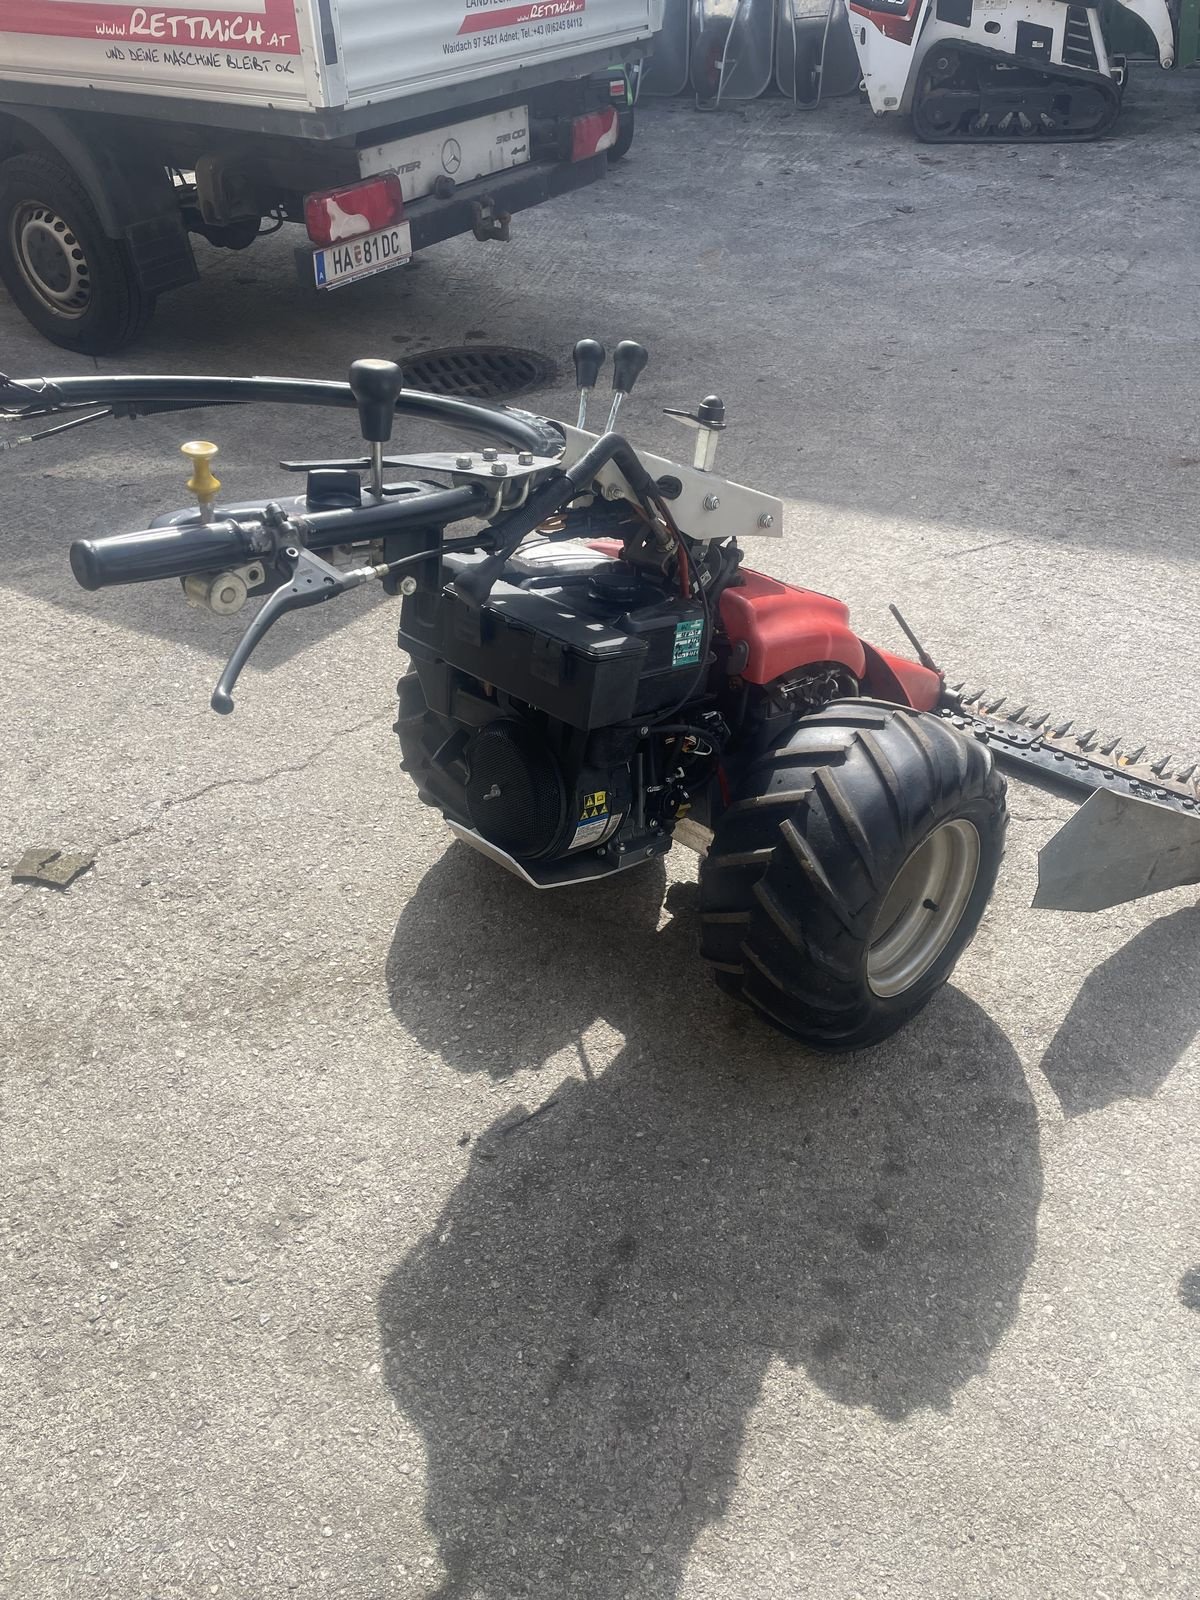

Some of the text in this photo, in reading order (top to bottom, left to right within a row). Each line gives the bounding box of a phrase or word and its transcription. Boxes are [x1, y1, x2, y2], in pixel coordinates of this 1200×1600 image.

[442, 39, 472, 54] Waidach
[473, 37, 481, 49] 97
[482, 34, 498, 47] 5421
[566, 17, 583, 30] 84112
[105, 45, 125, 60] UND
[275, 61, 294, 74] OK
[333, 247, 354, 275] HA
[319, 271, 326, 280] A
